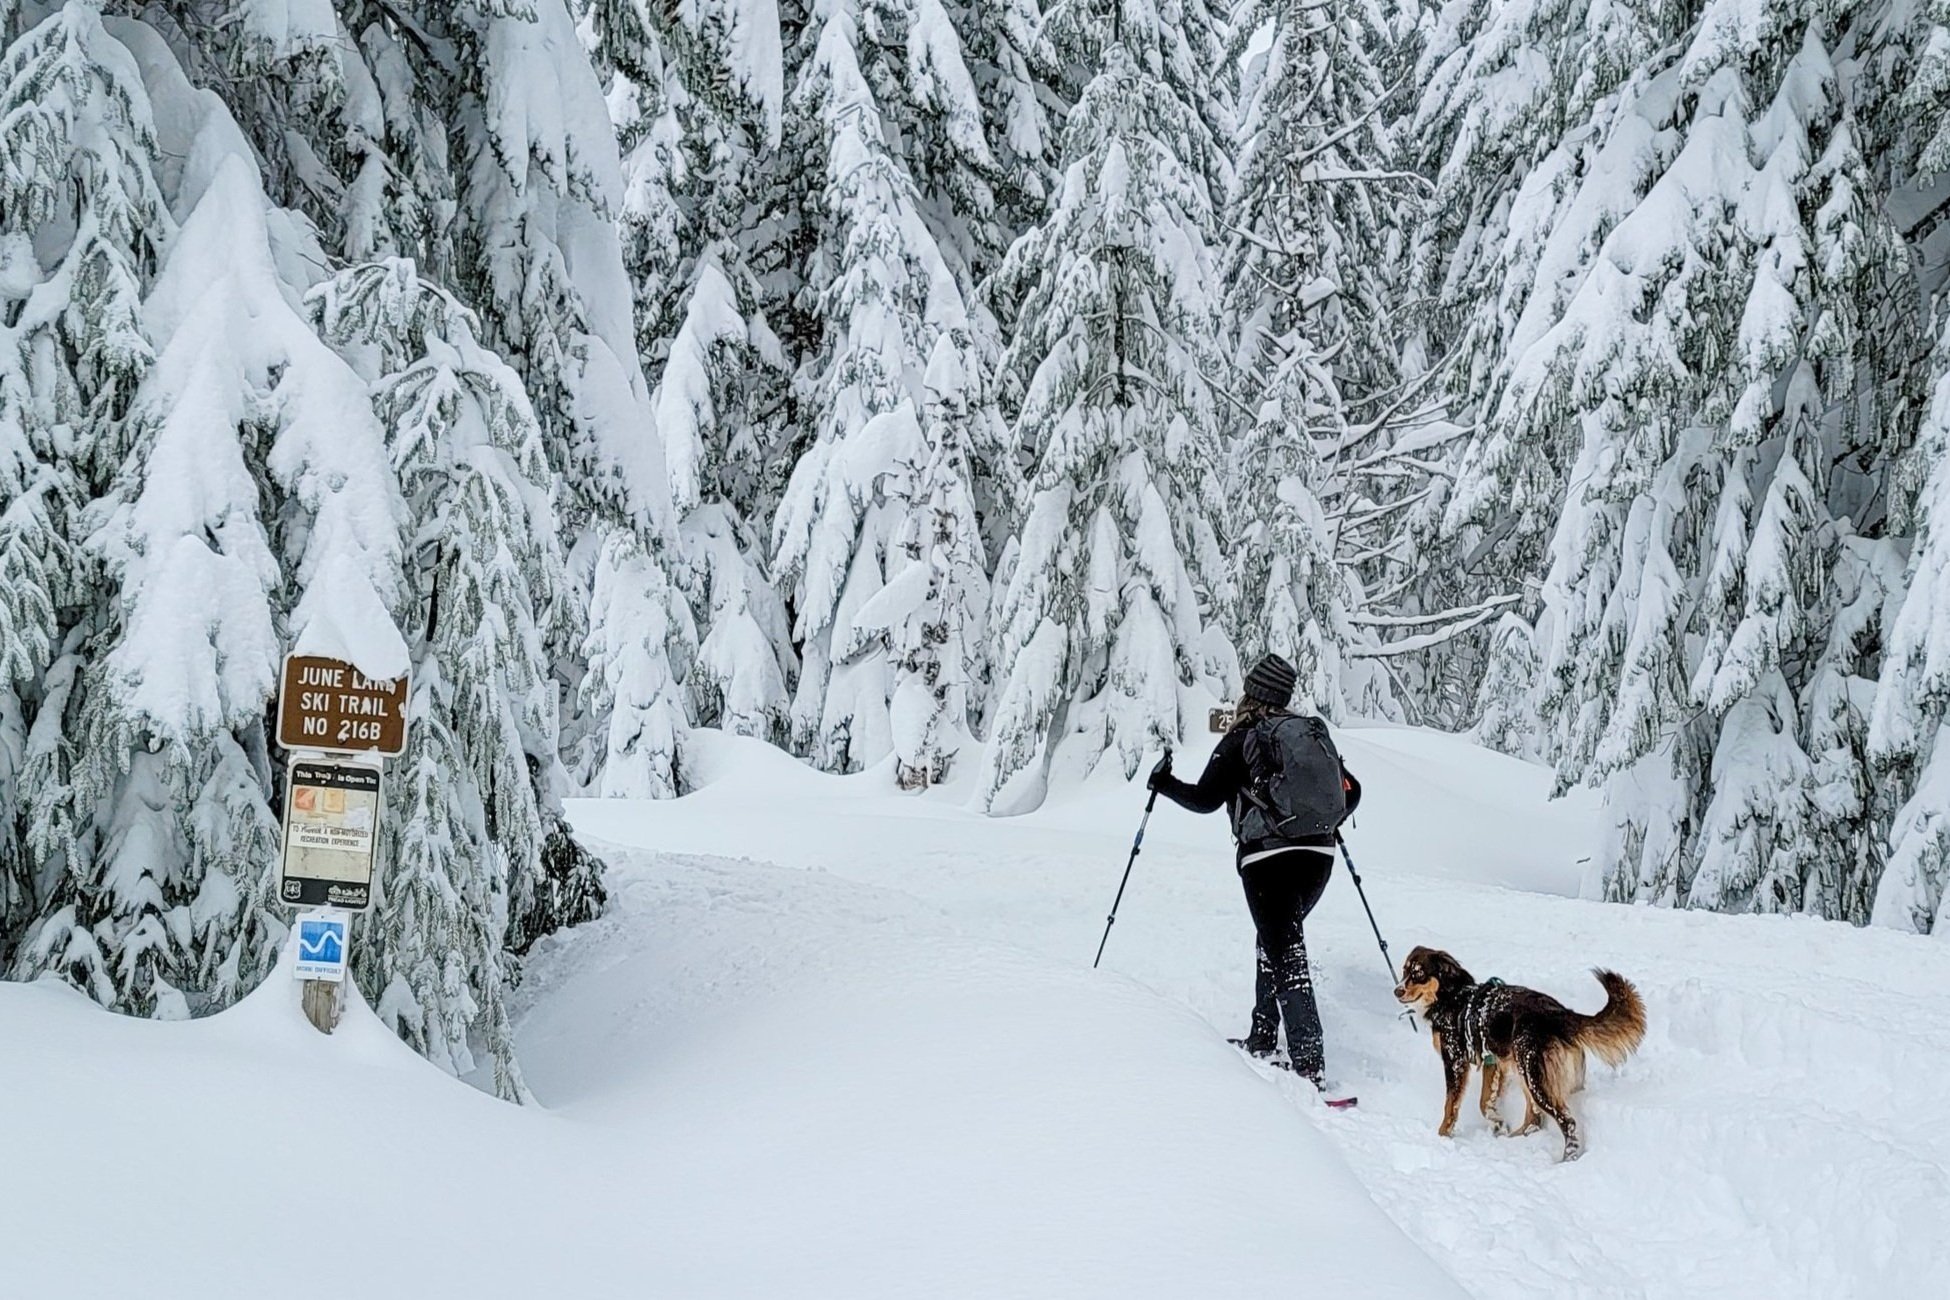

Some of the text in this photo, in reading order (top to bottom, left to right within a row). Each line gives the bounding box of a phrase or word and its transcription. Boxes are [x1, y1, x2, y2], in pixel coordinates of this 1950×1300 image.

[298, 667, 396, 694] JUNE LA
[300, 692, 389, 717] SKI TRAIL
[303, 716, 382, 741] NO 216B
[296, 770, 312, 779] This
[345, 775, 365, 784] Open
[331, 838, 359, 847] EXPERIENCE
